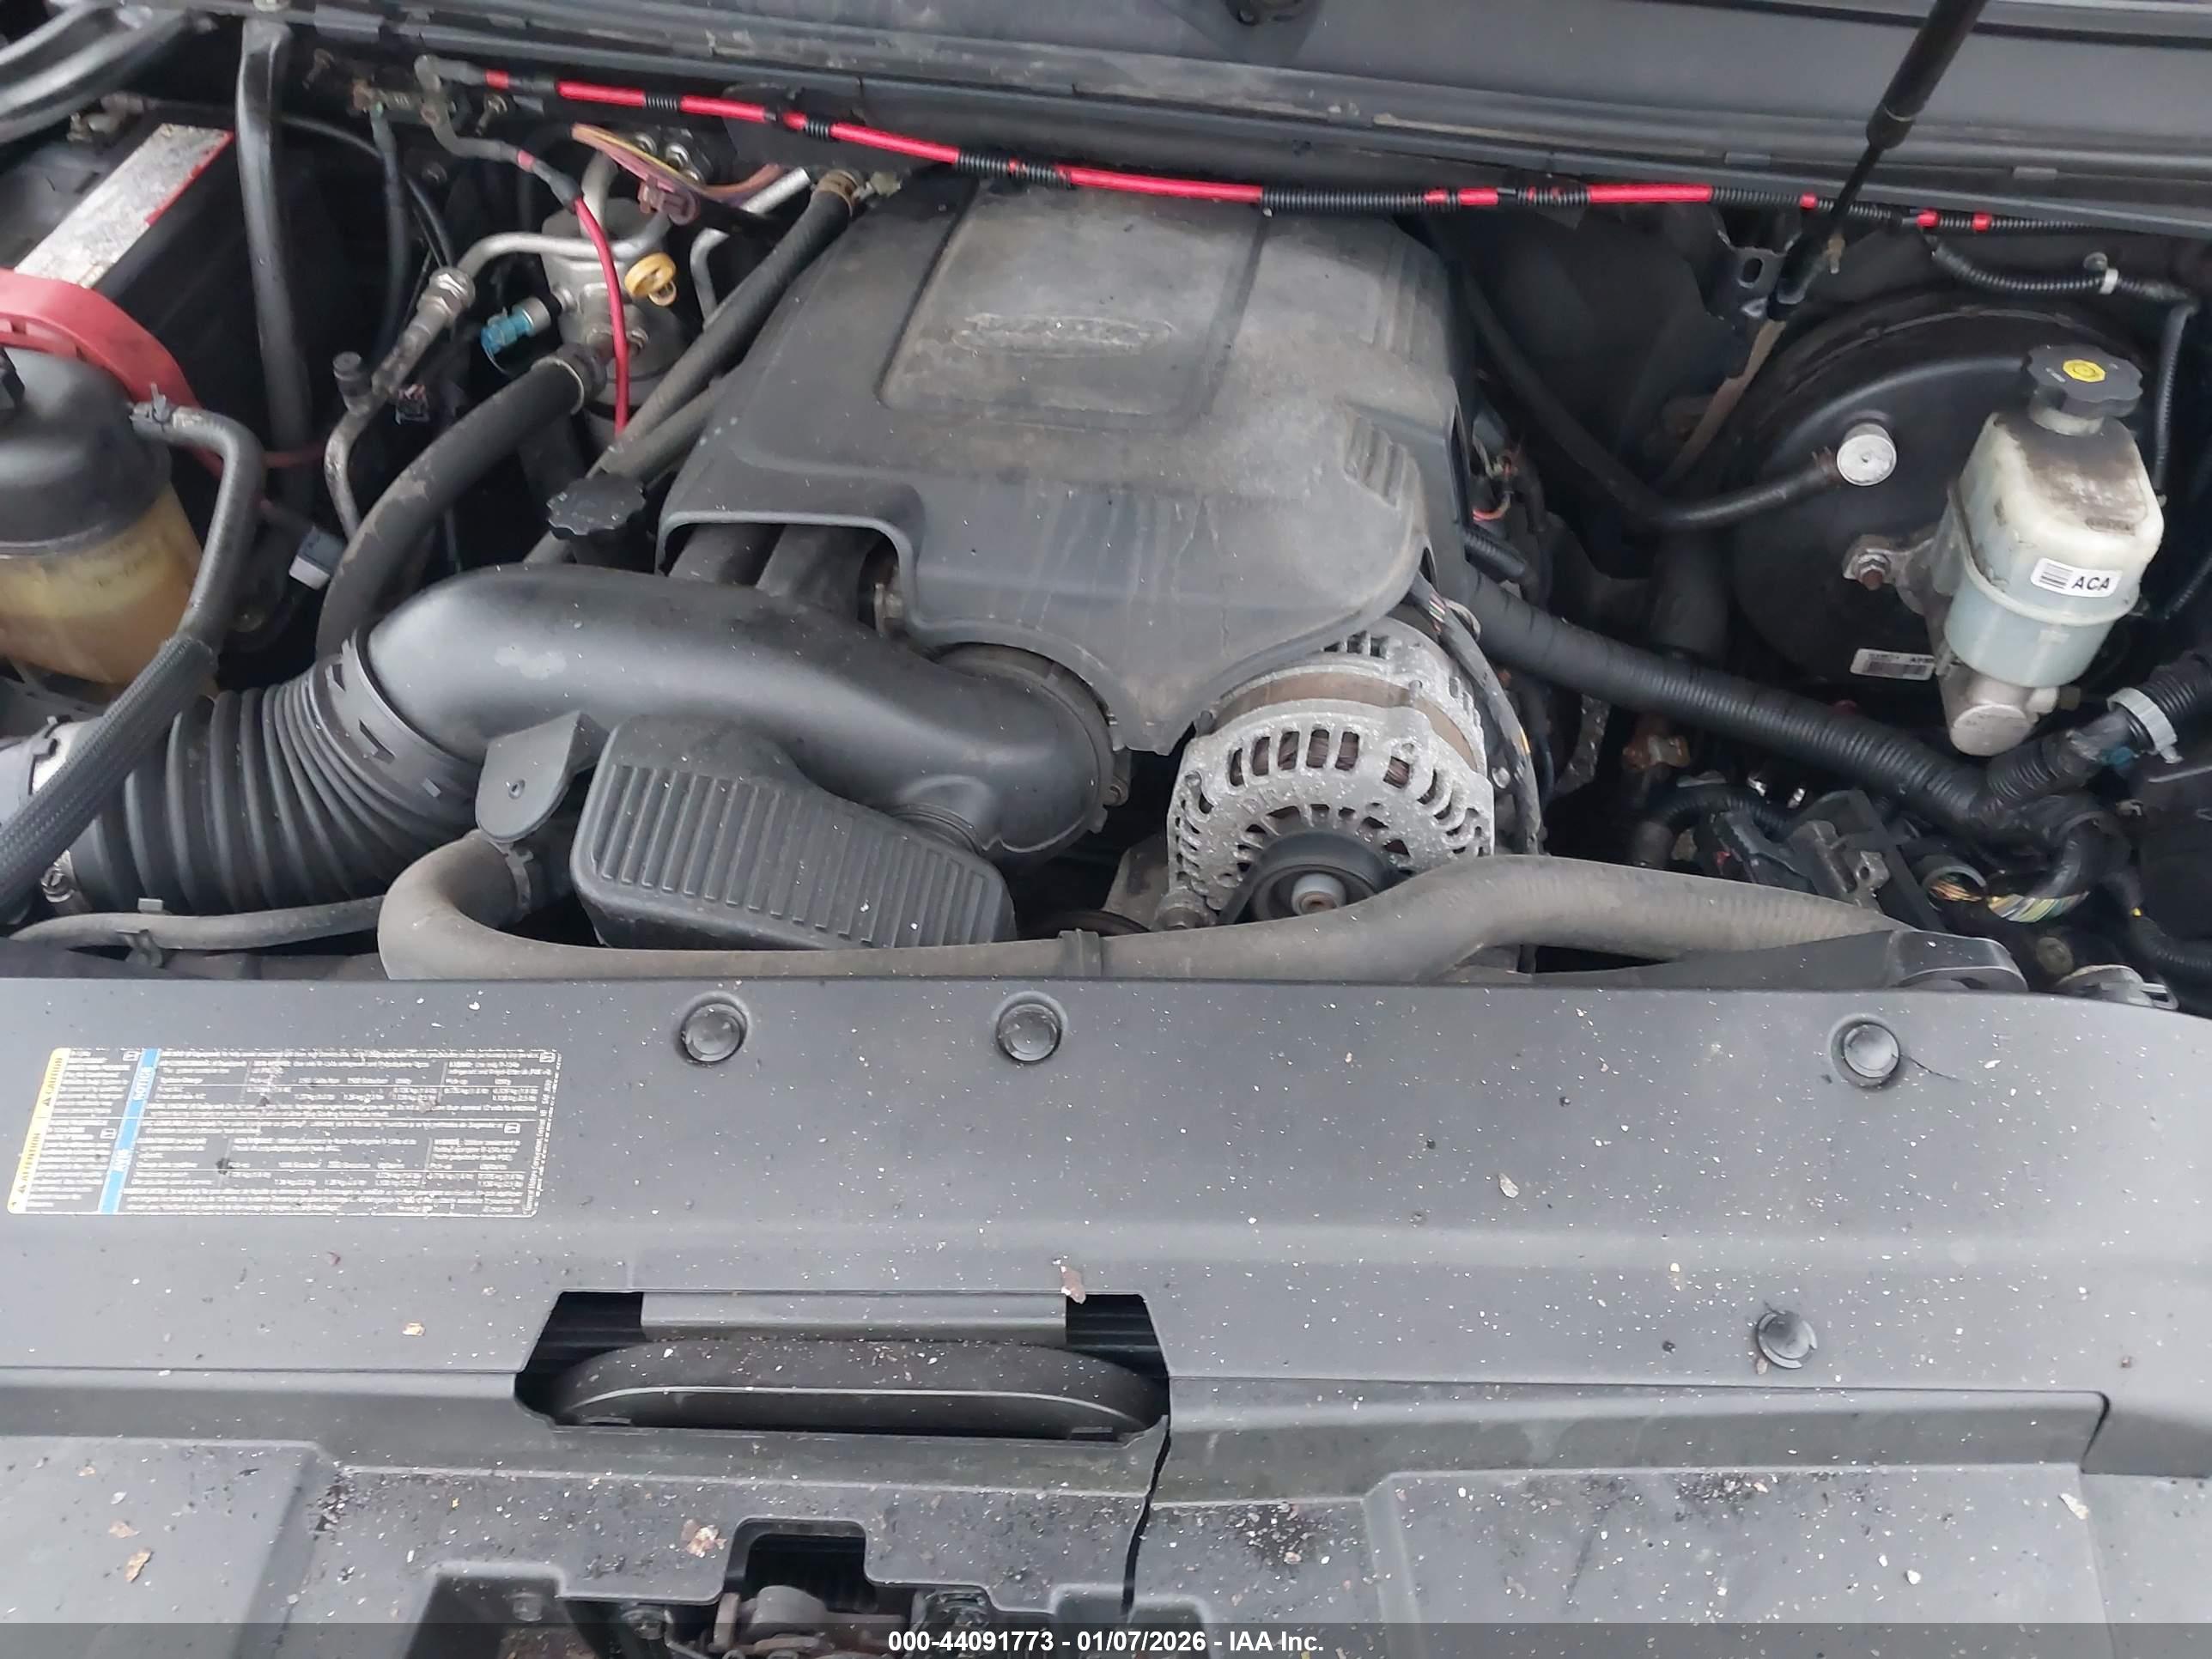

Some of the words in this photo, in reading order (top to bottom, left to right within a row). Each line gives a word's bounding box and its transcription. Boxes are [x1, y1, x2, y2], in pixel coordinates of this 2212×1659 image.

[2071, 576, 2110, 591] ACA
[46, 1057, 63, 1096] CAUTION
[133, 1066, 154, 1101] NOTICE
[22, 1133, 40, 1182] ATTENTION
